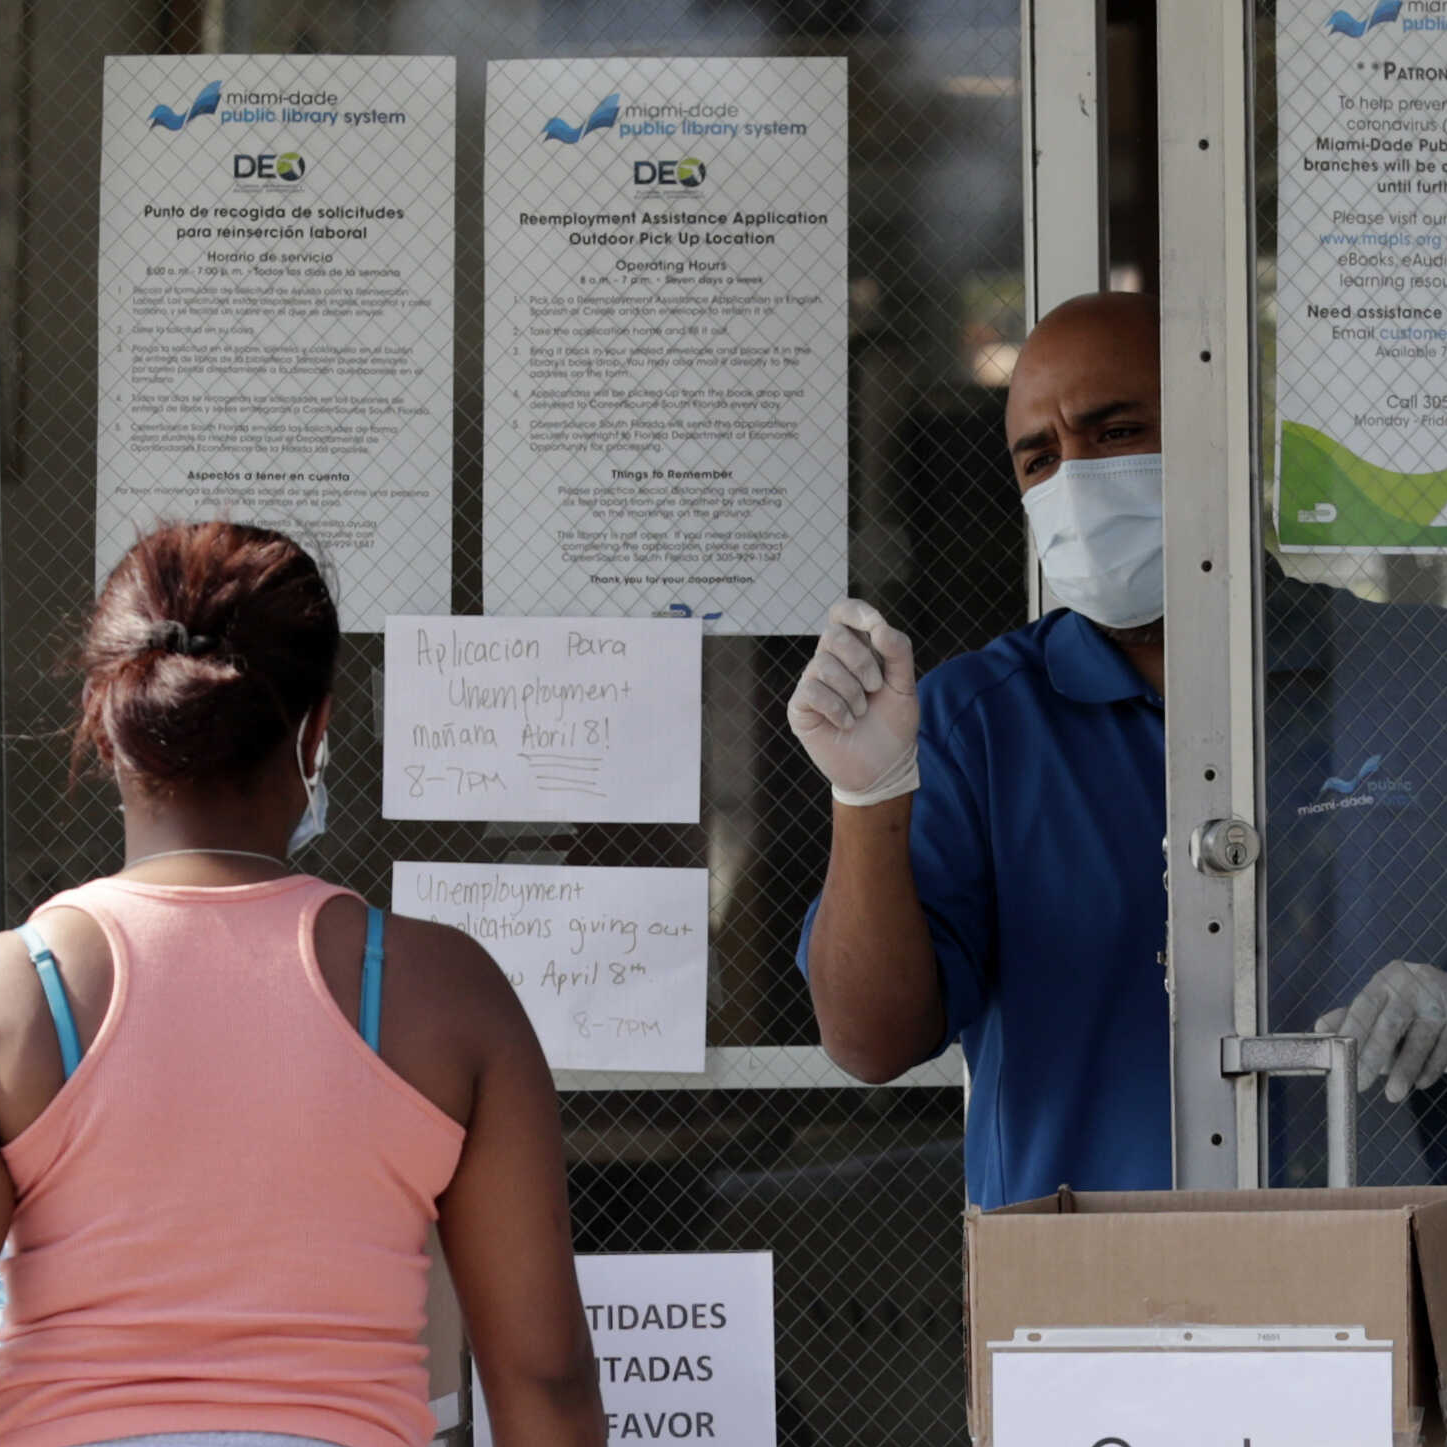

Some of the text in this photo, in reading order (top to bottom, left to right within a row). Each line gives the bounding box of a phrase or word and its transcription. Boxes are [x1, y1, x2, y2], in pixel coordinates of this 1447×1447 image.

[227, 90, 338, 105] miami-dade
[221, 108, 406, 126] public library system
[625, 102, 739, 118] miami-dade
[619, 121, 807, 138] public library system
[1317, 137, 1413, 151] Miami-Dade
[144, 206, 404, 222] Punto de recogida de solicitudes
[519, 211, 828, 228] Reemployment Assistance Application
[176, 225, 367, 241] para reinserción laboral
[569, 231, 775, 247] Outdoor Pick Up Location
[1307, 305, 1351, 319] Need
[1356, 306, 1442, 320] assistance
[1331, 326, 1375, 340] Email
[1386, 394, 1418, 409] Call
[567, 631, 627, 657] Para
[449, 676, 632, 721] Unemployment
[416, 873, 585, 915] Unemployment
[569, 914, 638, 955] giving
[648, 922, 693, 936] out
[541, 960, 599, 995] April
[586, 1303, 727, 1332] TIDADES
